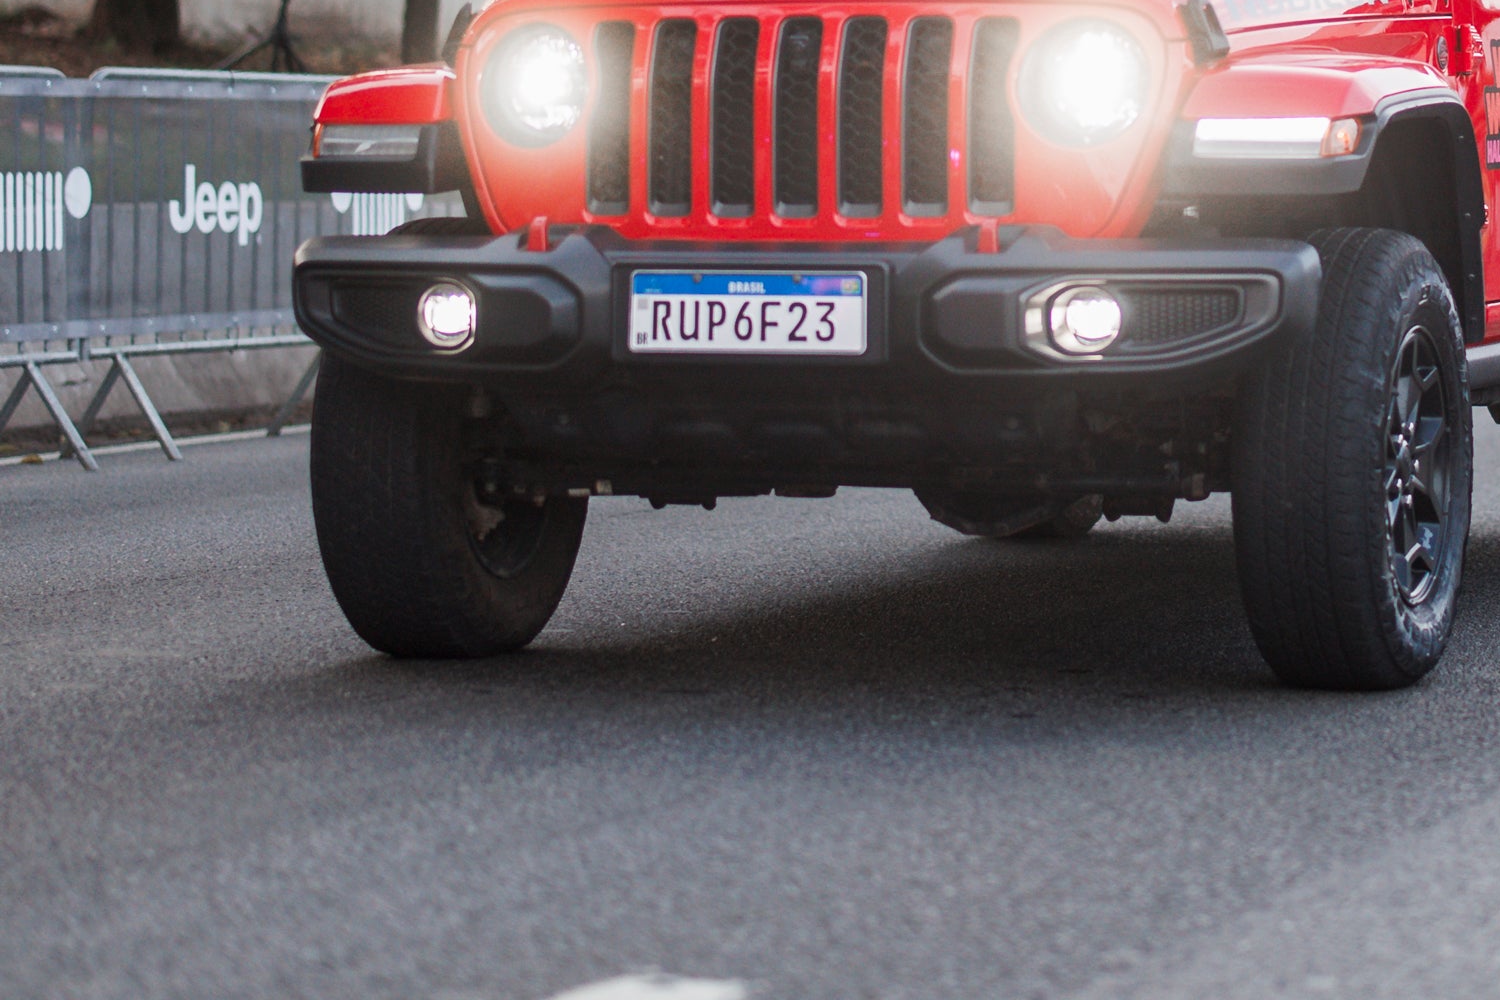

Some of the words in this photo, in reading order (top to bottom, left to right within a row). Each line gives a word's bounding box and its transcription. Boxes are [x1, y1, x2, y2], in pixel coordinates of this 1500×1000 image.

[169, 163, 263, 246] Jeep
[728, 281, 766, 293] BRASIL
[652, 300, 836, 342] RUP6F23
